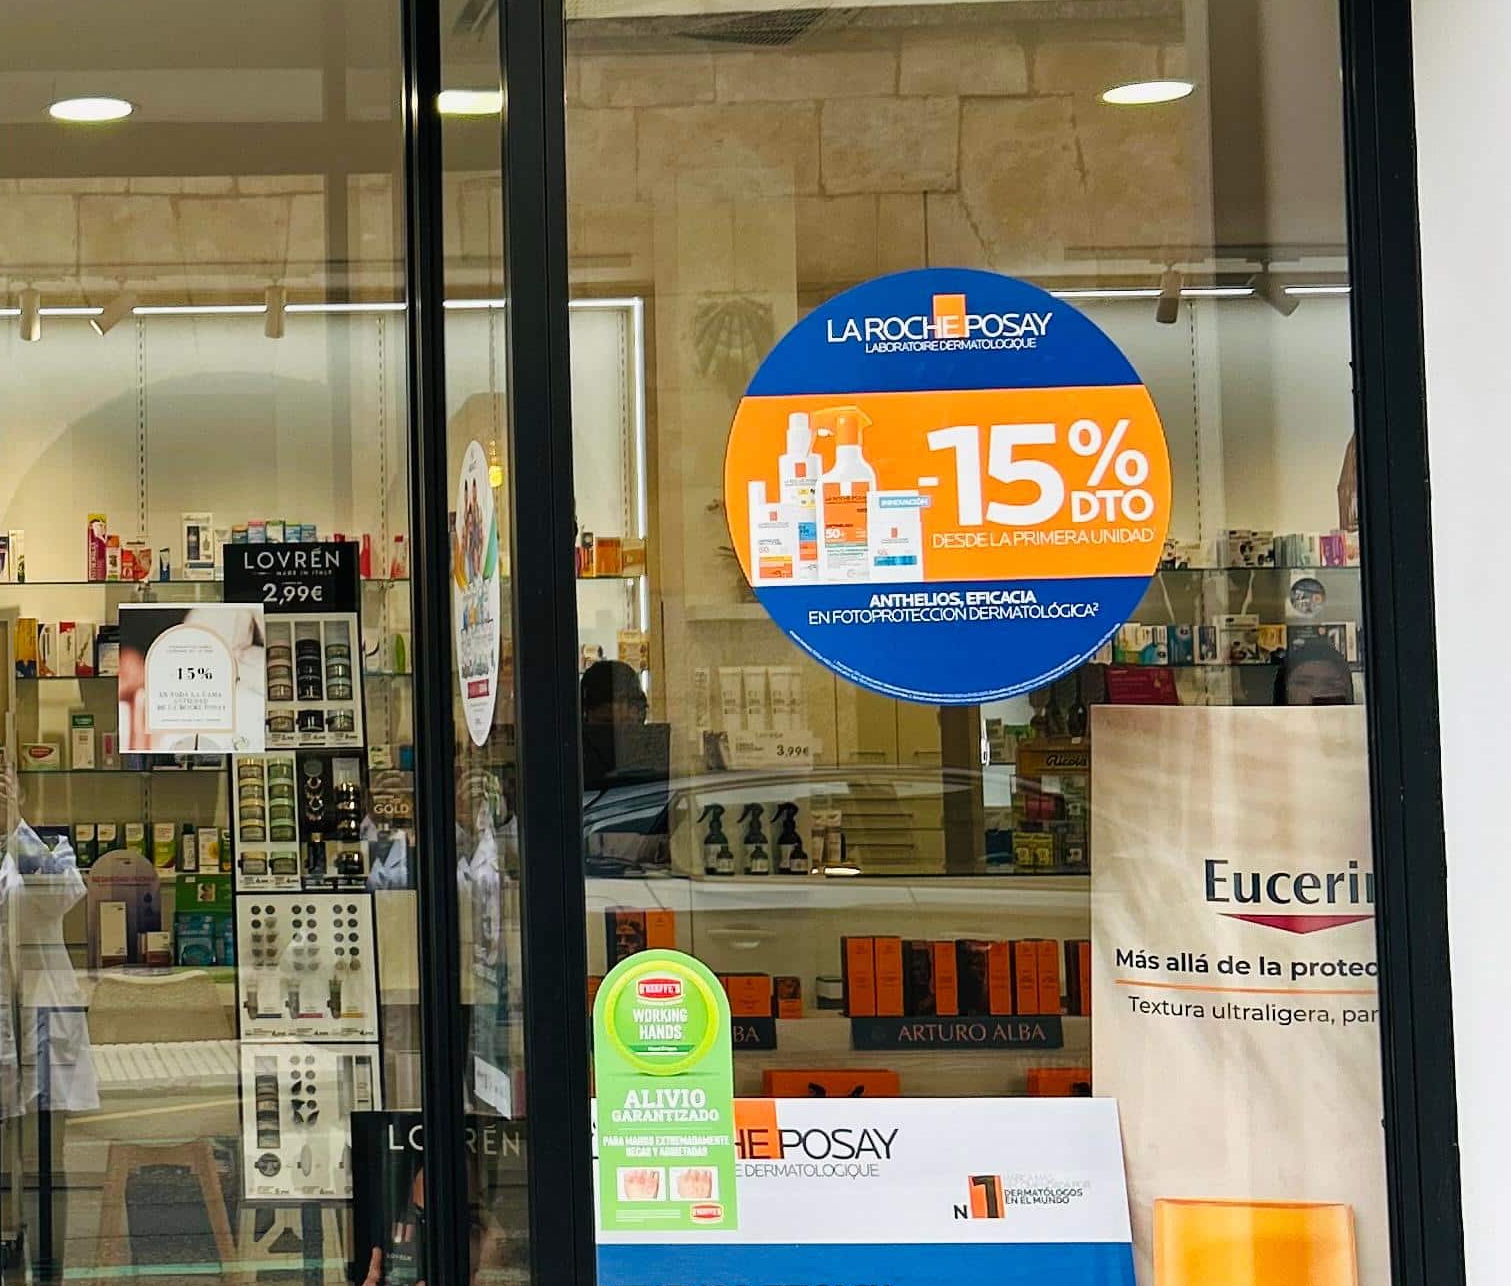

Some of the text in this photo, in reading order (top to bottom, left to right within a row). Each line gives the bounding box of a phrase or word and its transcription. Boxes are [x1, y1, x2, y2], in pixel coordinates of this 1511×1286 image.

[827, 312, 1053, 343] LA ROCHE POSAY
[865, 337, 1037, 354] LABORATOIRE DERMATOLOGIQUE
[918, 418, 1149, 526] -15%
[1071, 489, 1154, 523] DTO
[933, 527, 1153, 549] DESDE LA PRIMERA UNIDAD
[244, 546, 340, 569] LOVRÉN
[262, 583, 323, 605] 2,99€
[869, 590, 1036, 608] ANTHELIOS, EFICACIA
[808, 610, 830, 625] EN
[374, 803, 409, 814] GOLD
[1116, 949, 1160, 970] Más
[1166, 952, 1209, 973] allá
[1217, 956, 1251, 976] de
[1260, 956, 1282, 976] la
[632, 1007, 688, 1023] WORKING
[1128, 995, 1205, 1018] Textura
[1212, 1002, 1336, 1026] ultraligera,
[639, 1024, 683, 1040] HANDS
[898, 1024, 1047, 1042] ARTURO ALBA
[623, 1089, 706, 1109] ALIVIO
[611, 1109, 720, 1122] GARANTIZADO
[778, 1127, 899, 1160] POSAY
[745, 1164, 880, 1180] DERMATOLOGIQUE
[1004, 1187, 1083, 1197] DERMATÓLOGOS
[1020, 1196, 1031, 1204] EL
[1033, 1195, 1070, 1204] MUNDO
